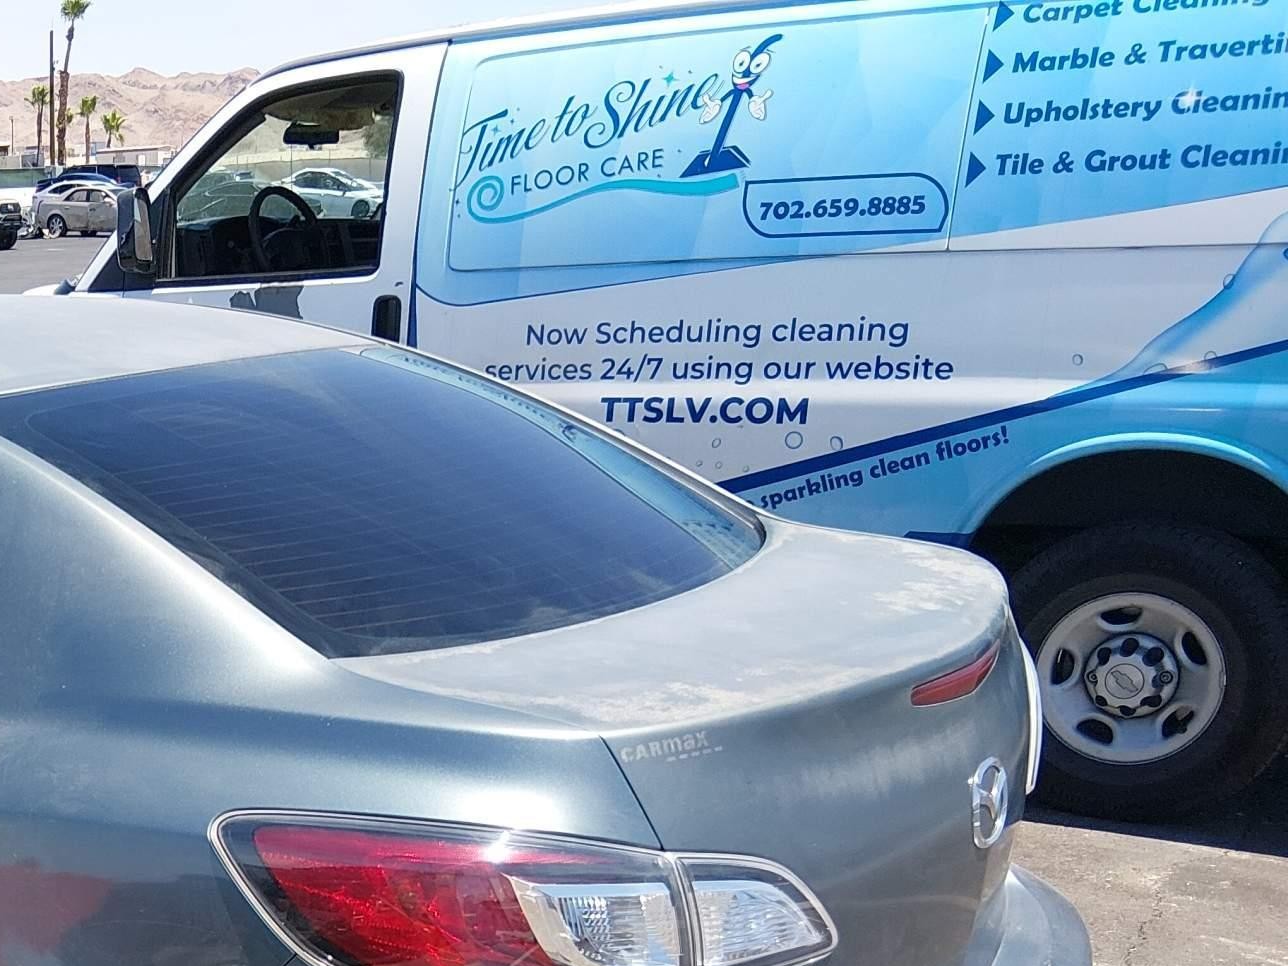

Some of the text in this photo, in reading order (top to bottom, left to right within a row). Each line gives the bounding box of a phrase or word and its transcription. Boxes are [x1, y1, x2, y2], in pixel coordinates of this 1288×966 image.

[1023, 0, 1122, 23] Carpet
[1011, 47, 1115, 74] Marble
[1124, 43, 1147, 65] &
[1002, 98, 1163, 128] Upholstery
[456, 73, 720, 188] Time to Shine
[510, 149, 664, 196] FLOOR CARE
[995, 152, 1045, 176] Tile
[1052, 151, 1075, 174] &
[1084, 148, 1172, 172] Grout
[760, 195, 926, 221] 702.659.8885
[525, 316, 910, 348] Now Scheduling cleaning
[485, 355, 954, 385] services 24/7 using our website
[600, 397, 810, 425] TTSLV.COM
[760, 425, 1011, 510] sparkling clean floors!
